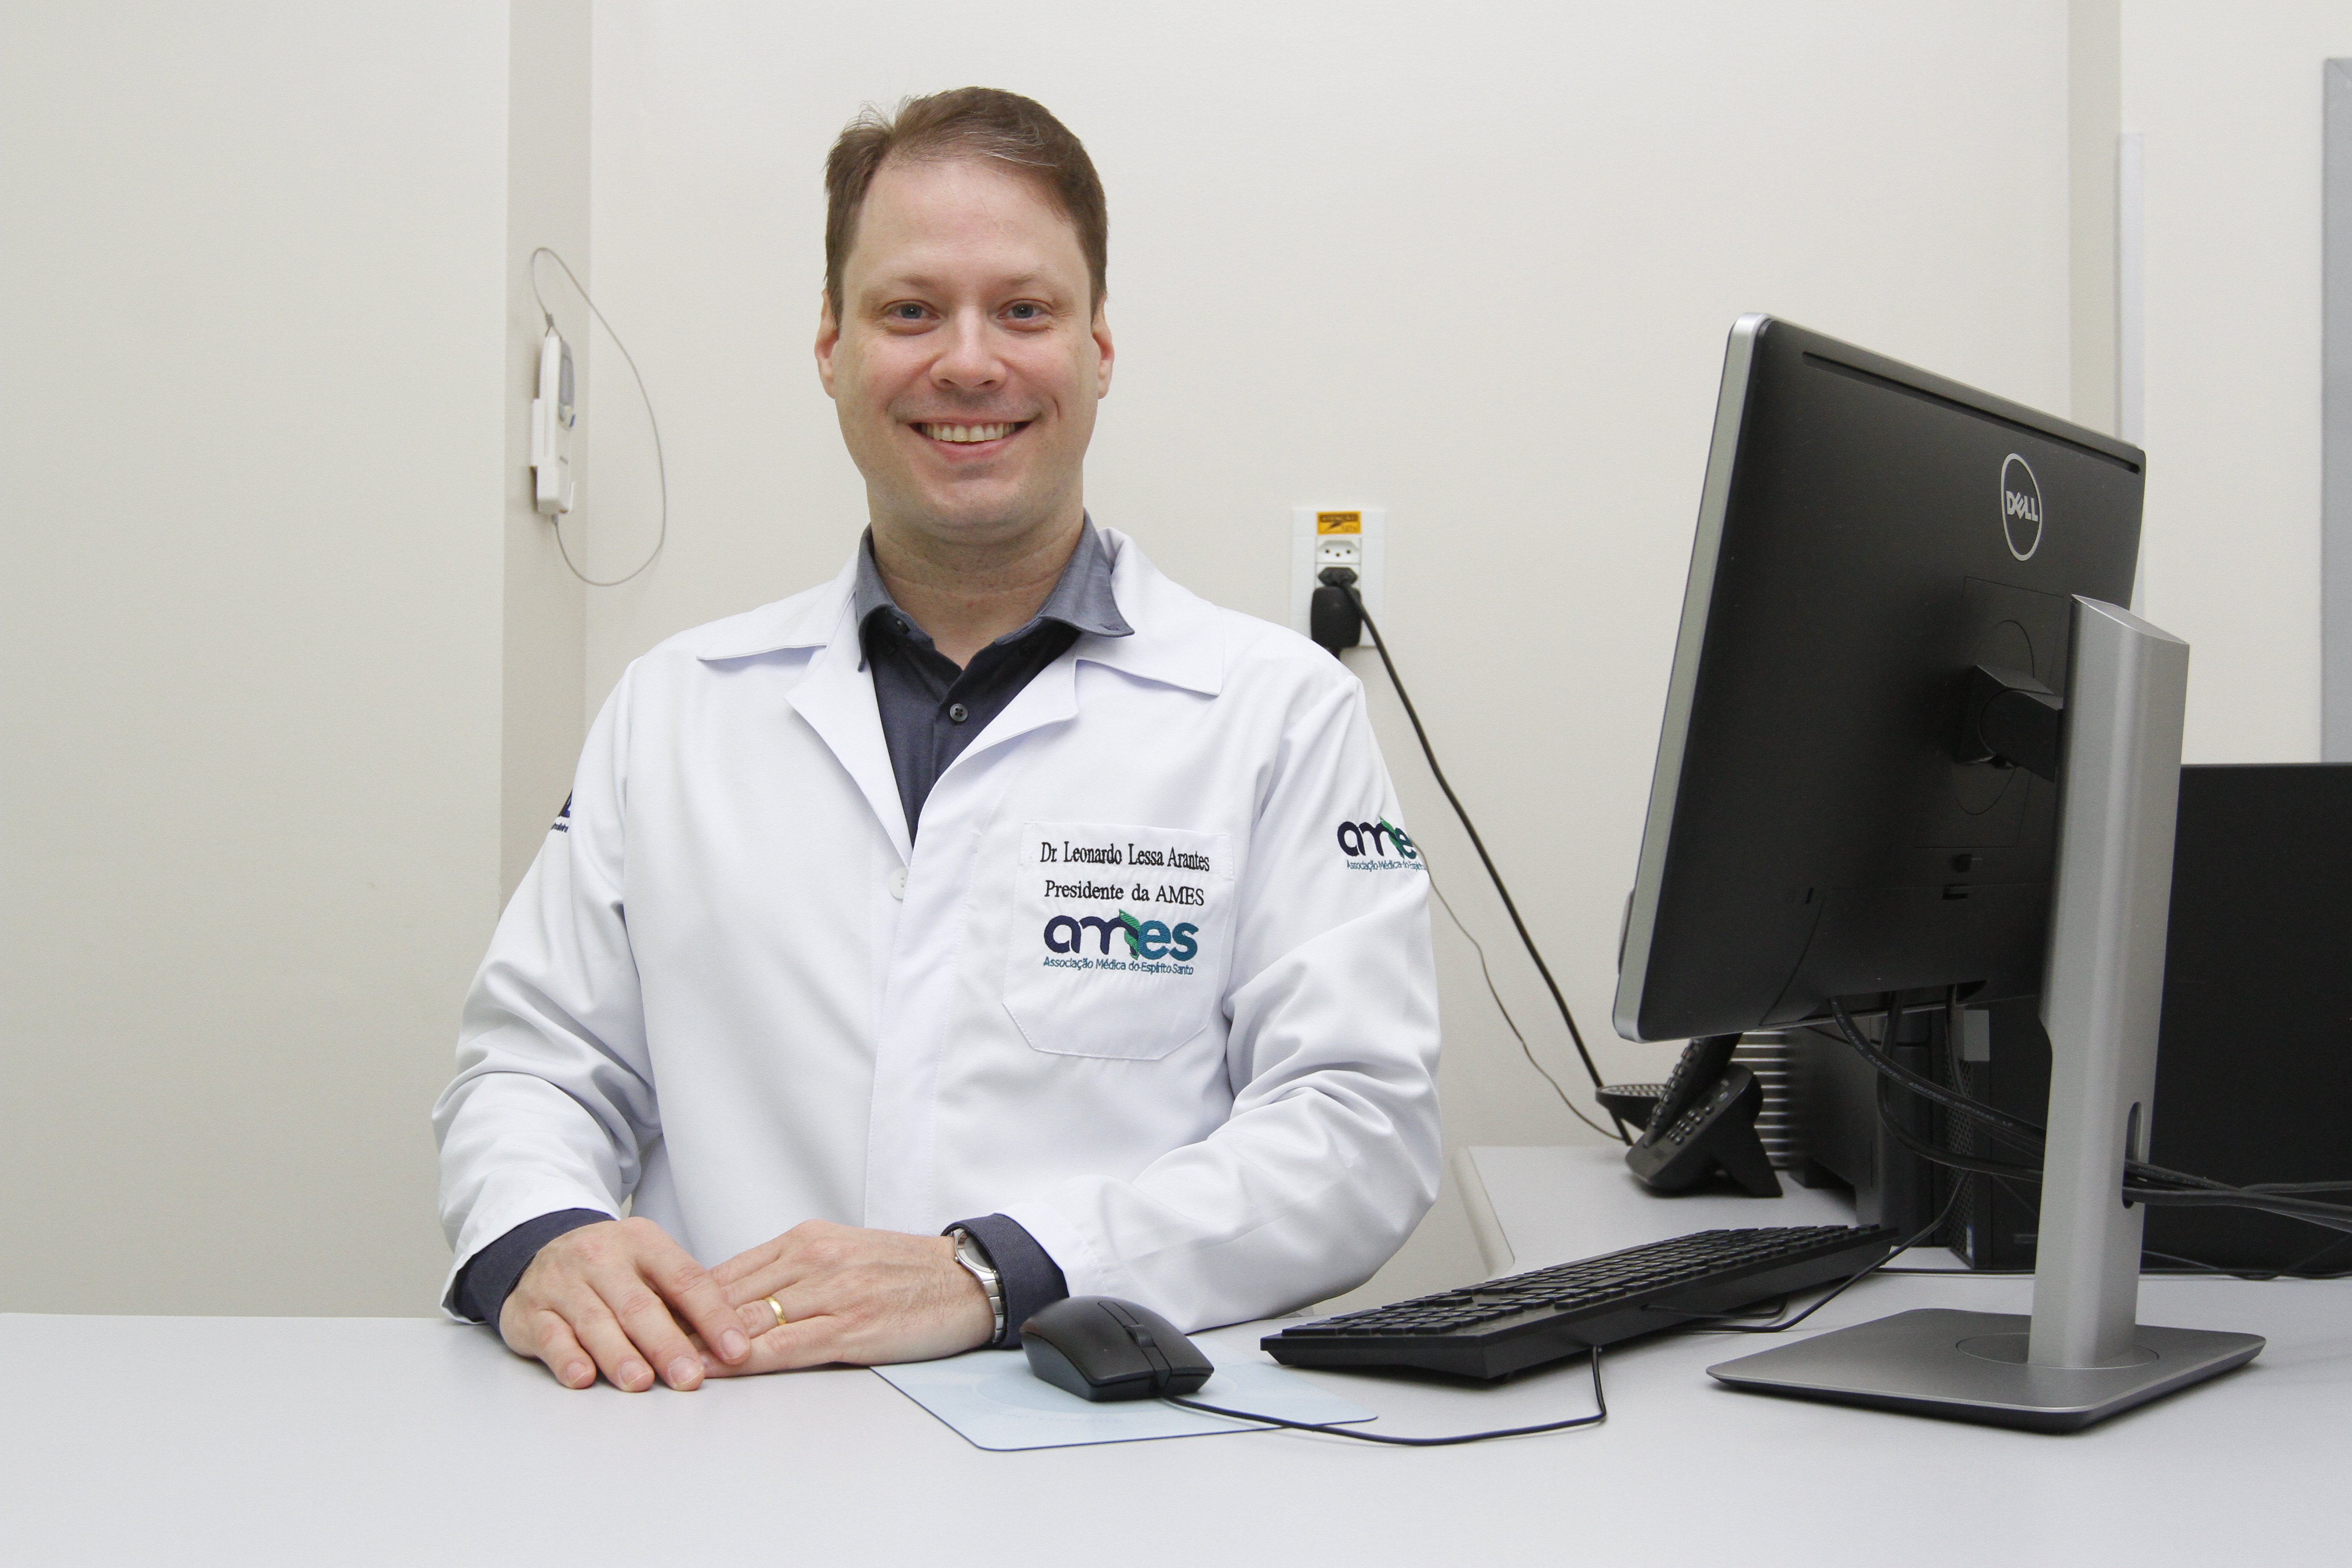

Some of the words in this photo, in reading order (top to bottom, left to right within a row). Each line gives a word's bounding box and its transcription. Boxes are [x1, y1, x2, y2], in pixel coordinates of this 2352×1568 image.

[2005, 490, 2038, 522] DELL
[1063, 841, 1122, 865] Leonardo
[1128, 843, 1164, 866] Lessa
[1167, 846, 1210, 872] Arantes
[1044, 880, 1124, 900] Presidente
[1132, 883, 1150, 901] da
[1156, 885, 1205, 906] AMES
[1044, 910, 1199, 962] ames
[1043, 956, 1093, 970] Associação
[1095, 958, 1126, 970] Médica
[1128, 960, 1140, 971] do
[1141, 961, 1171, 975] Espírito
[1172, 964, 1194, 975] Santo
